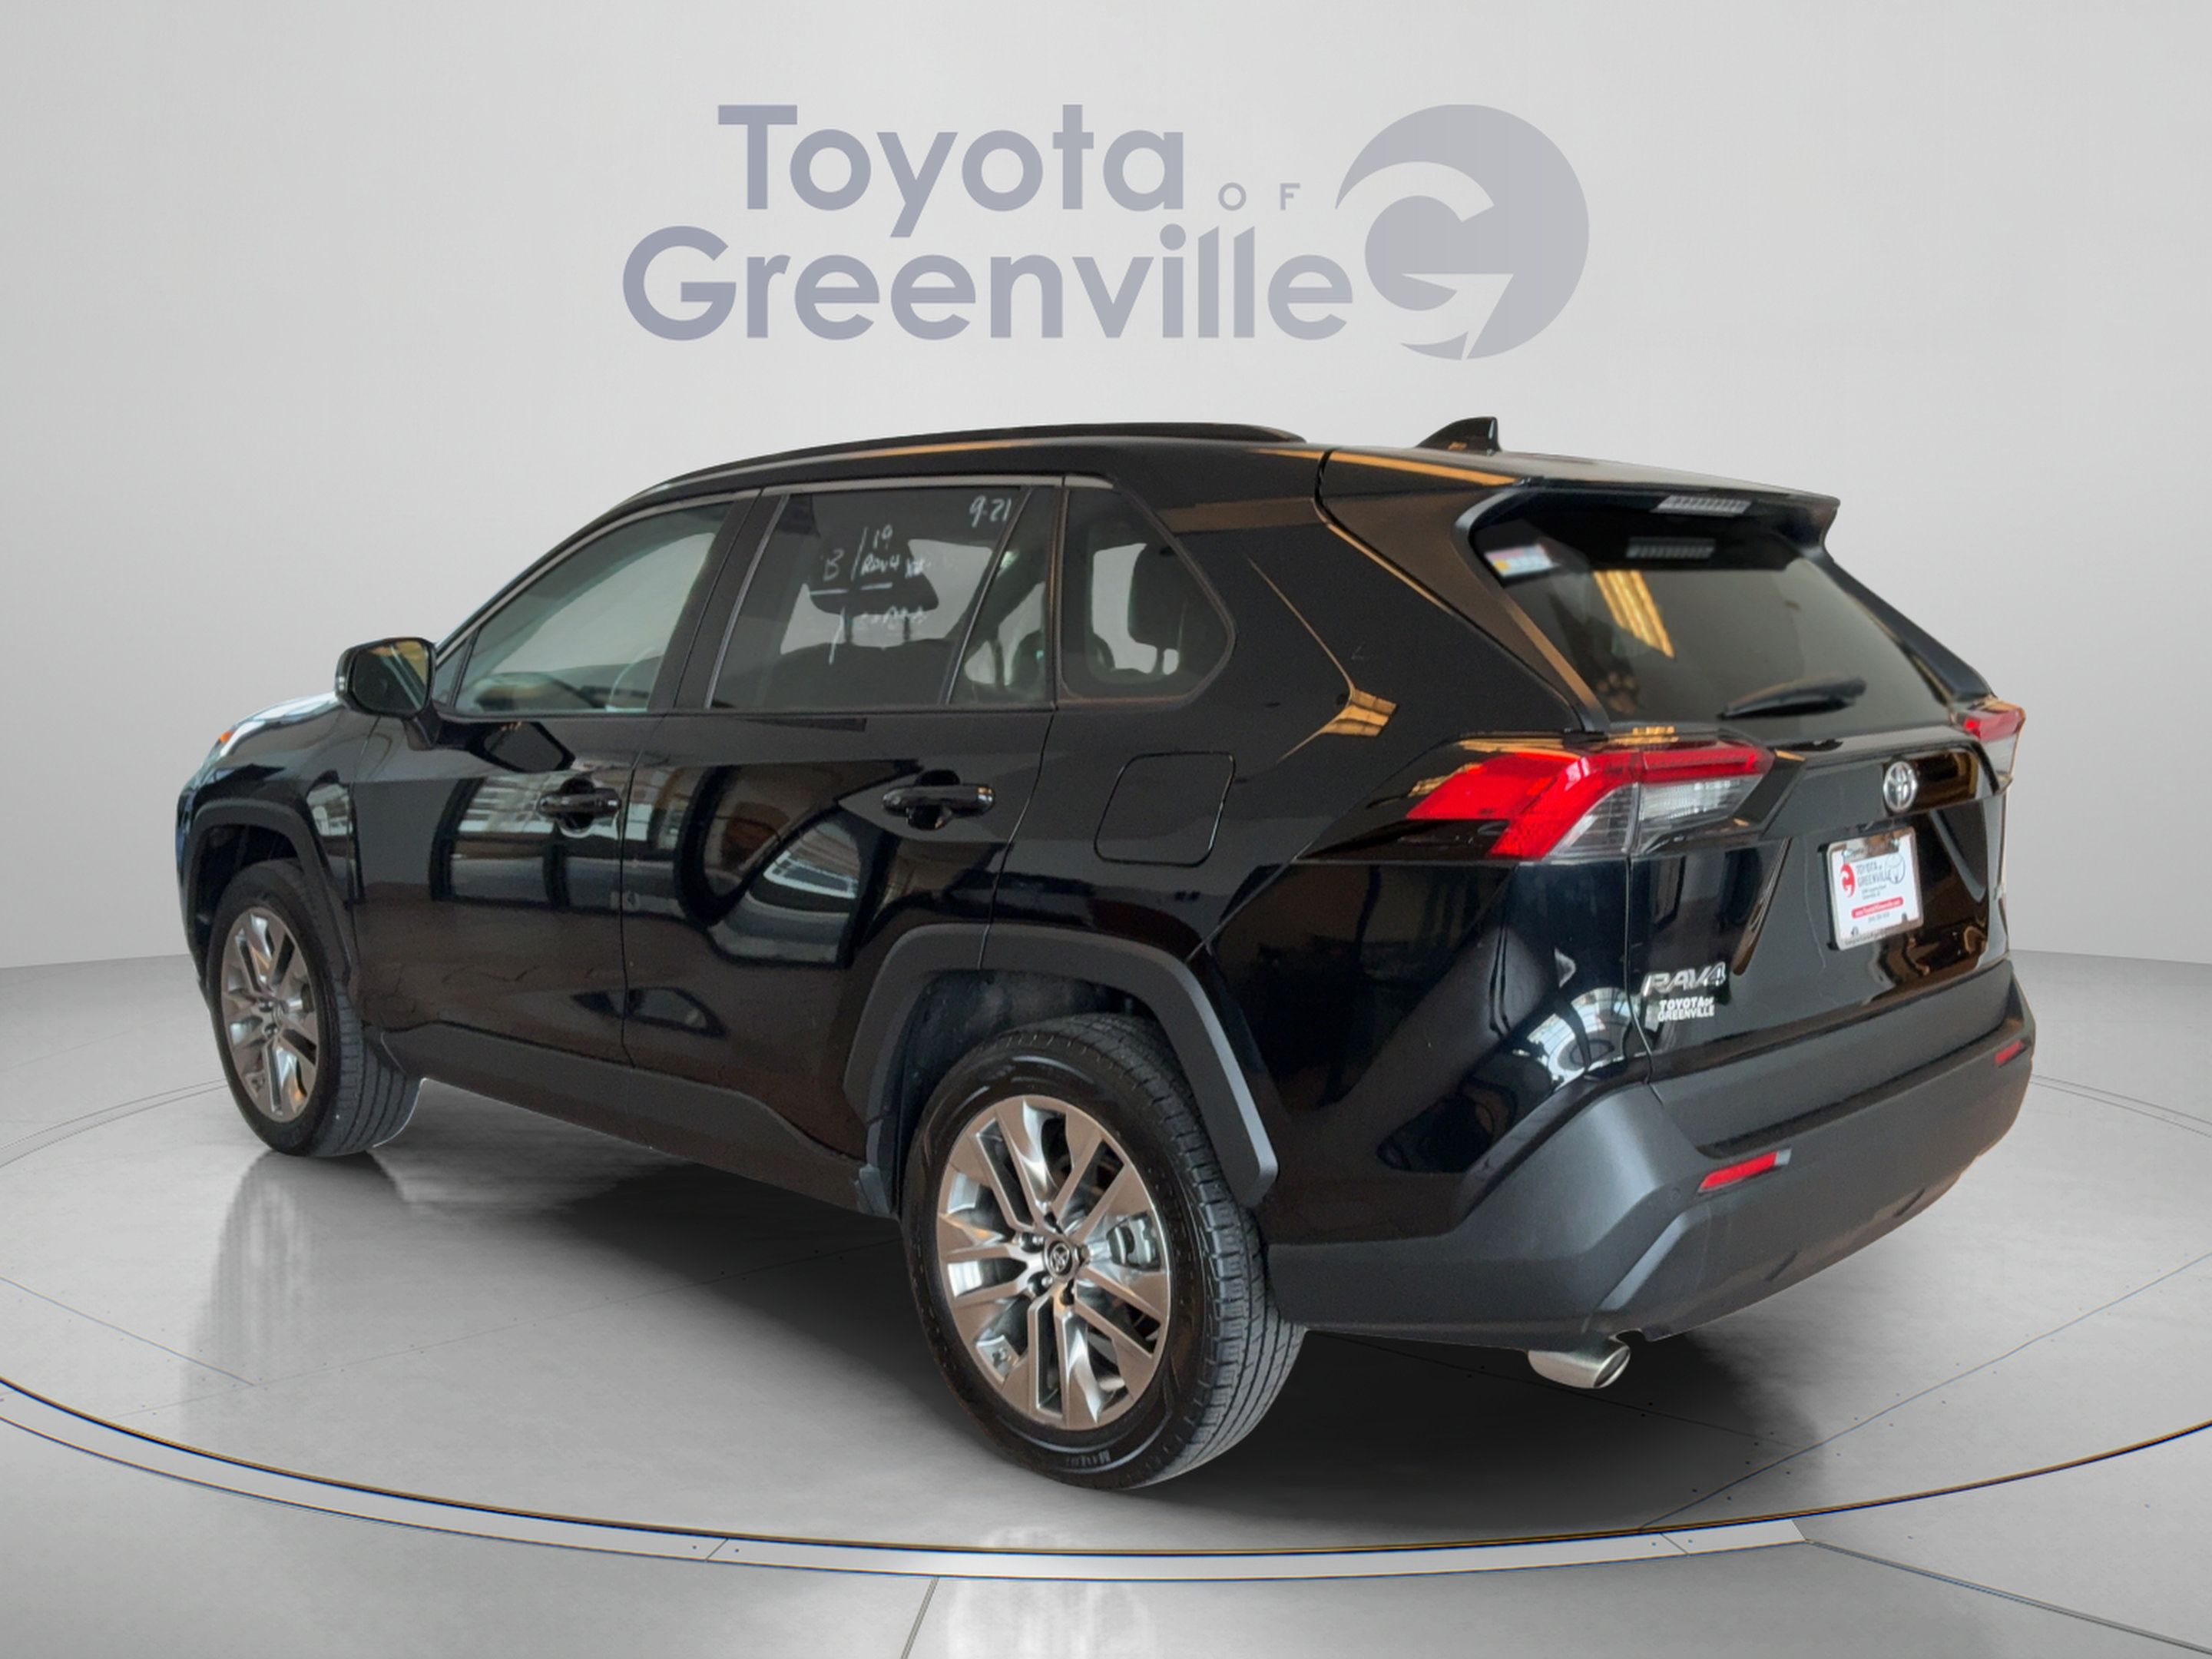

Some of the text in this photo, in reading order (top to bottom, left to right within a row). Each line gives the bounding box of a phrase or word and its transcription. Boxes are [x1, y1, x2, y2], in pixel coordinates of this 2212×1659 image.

[718, 104, 1301, 238] Toyota OF
[621, 223, 1353, 341] Greenville
[1640, 962, 1727, 997] RAV4
[1657, 1004, 1715, 1022] GREENVILLE
[1659, 996, 1705, 1012] TOYOTA
